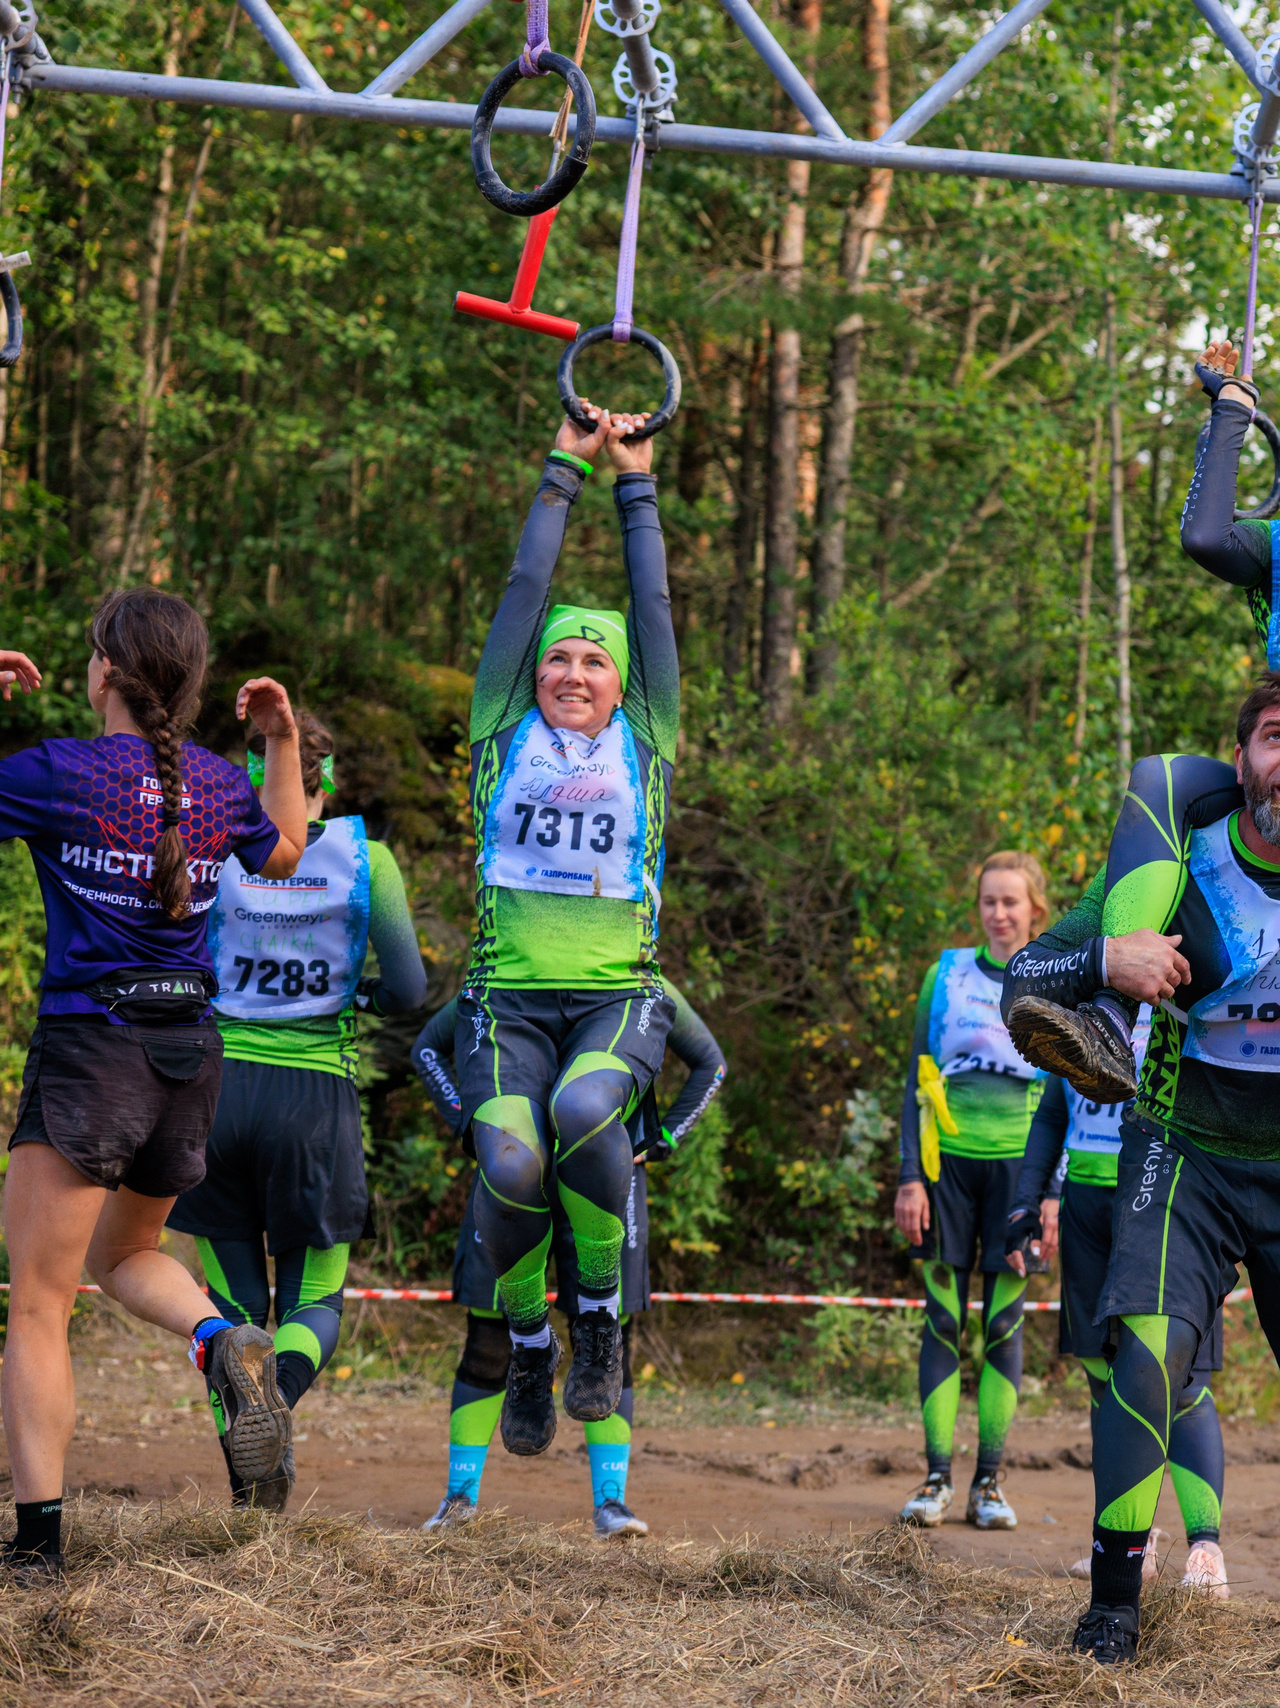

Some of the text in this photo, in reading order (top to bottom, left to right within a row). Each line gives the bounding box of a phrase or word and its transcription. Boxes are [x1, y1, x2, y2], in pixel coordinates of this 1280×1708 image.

[140, 792, 191, 808] ГЕРВ
[514, 803, 616, 854] 7313
[240, 875, 278, 886] ГОНКА
[541, 869, 594, 882] ГАЗПРОМБАНК
[235, 908, 319, 925] Greenway
[241, 932, 317, 954] CHAIKA
[1010, 950, 1088, 978] Greenway
[233, 955, 330, 997] 7283
[149, 980, 197, 994] TRAIL
